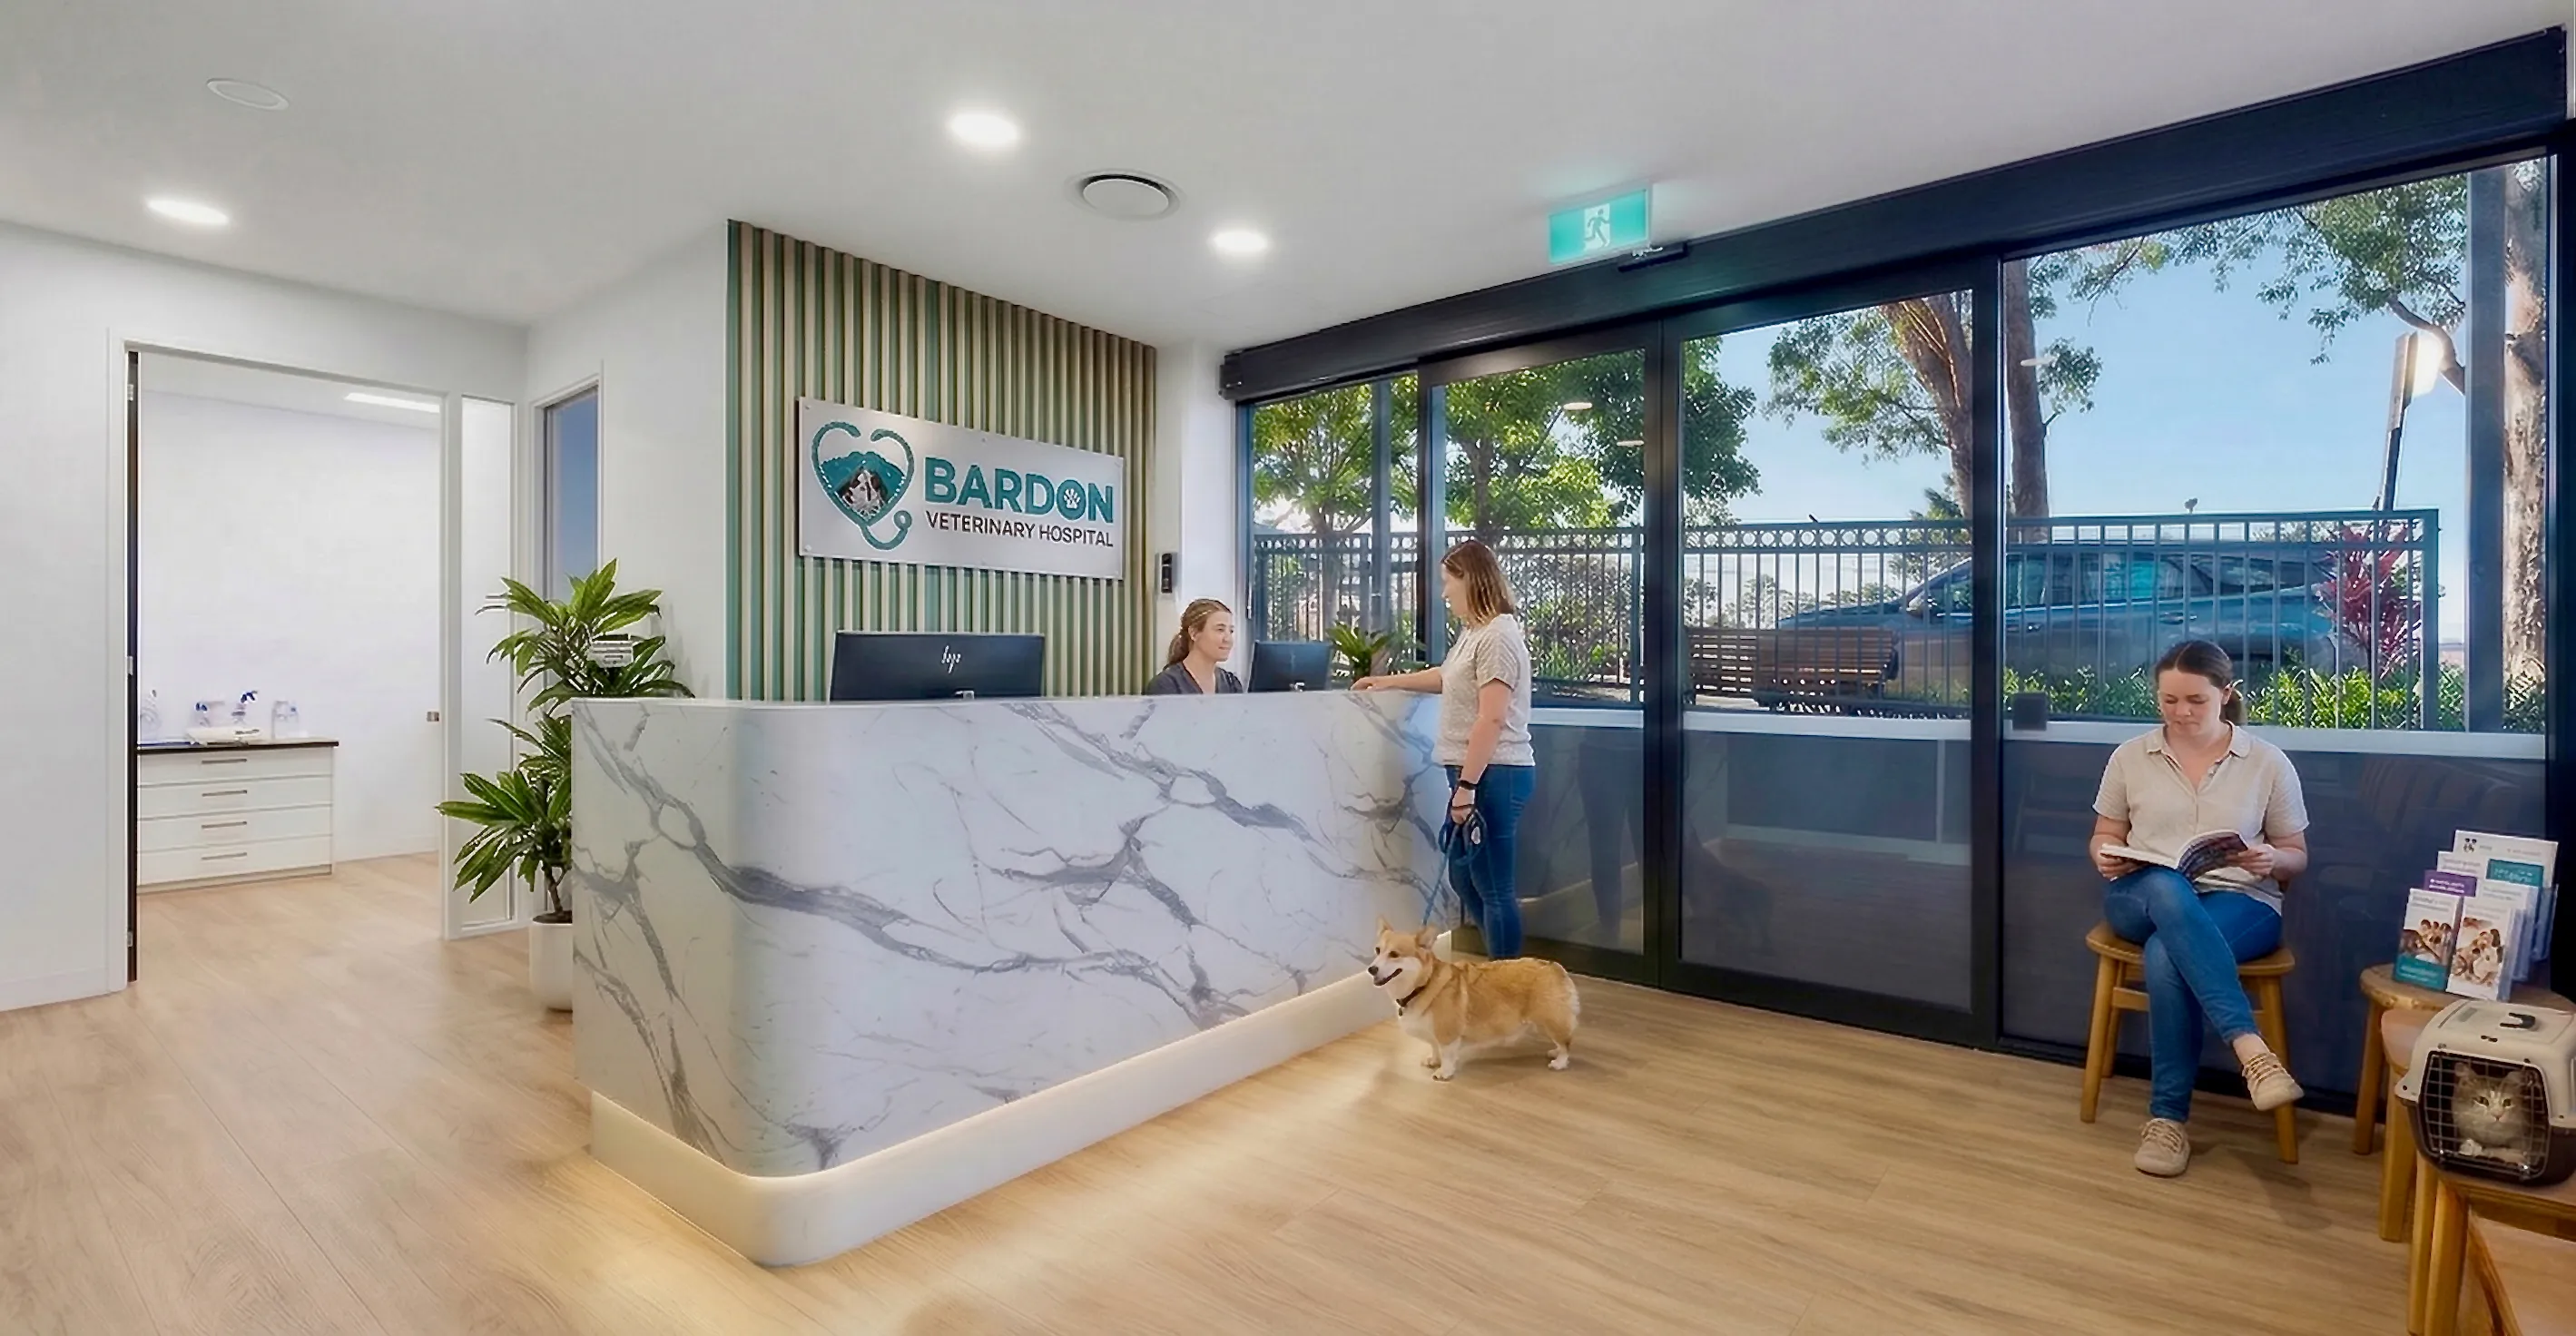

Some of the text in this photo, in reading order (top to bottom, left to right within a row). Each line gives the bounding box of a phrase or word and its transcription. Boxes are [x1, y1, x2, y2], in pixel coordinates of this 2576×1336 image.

[924, 457, 1113, 523] BARDON
[925, 510, 1114, 547] VETERINARY HOSPITAL
[941, 644, 961, 673] hp
